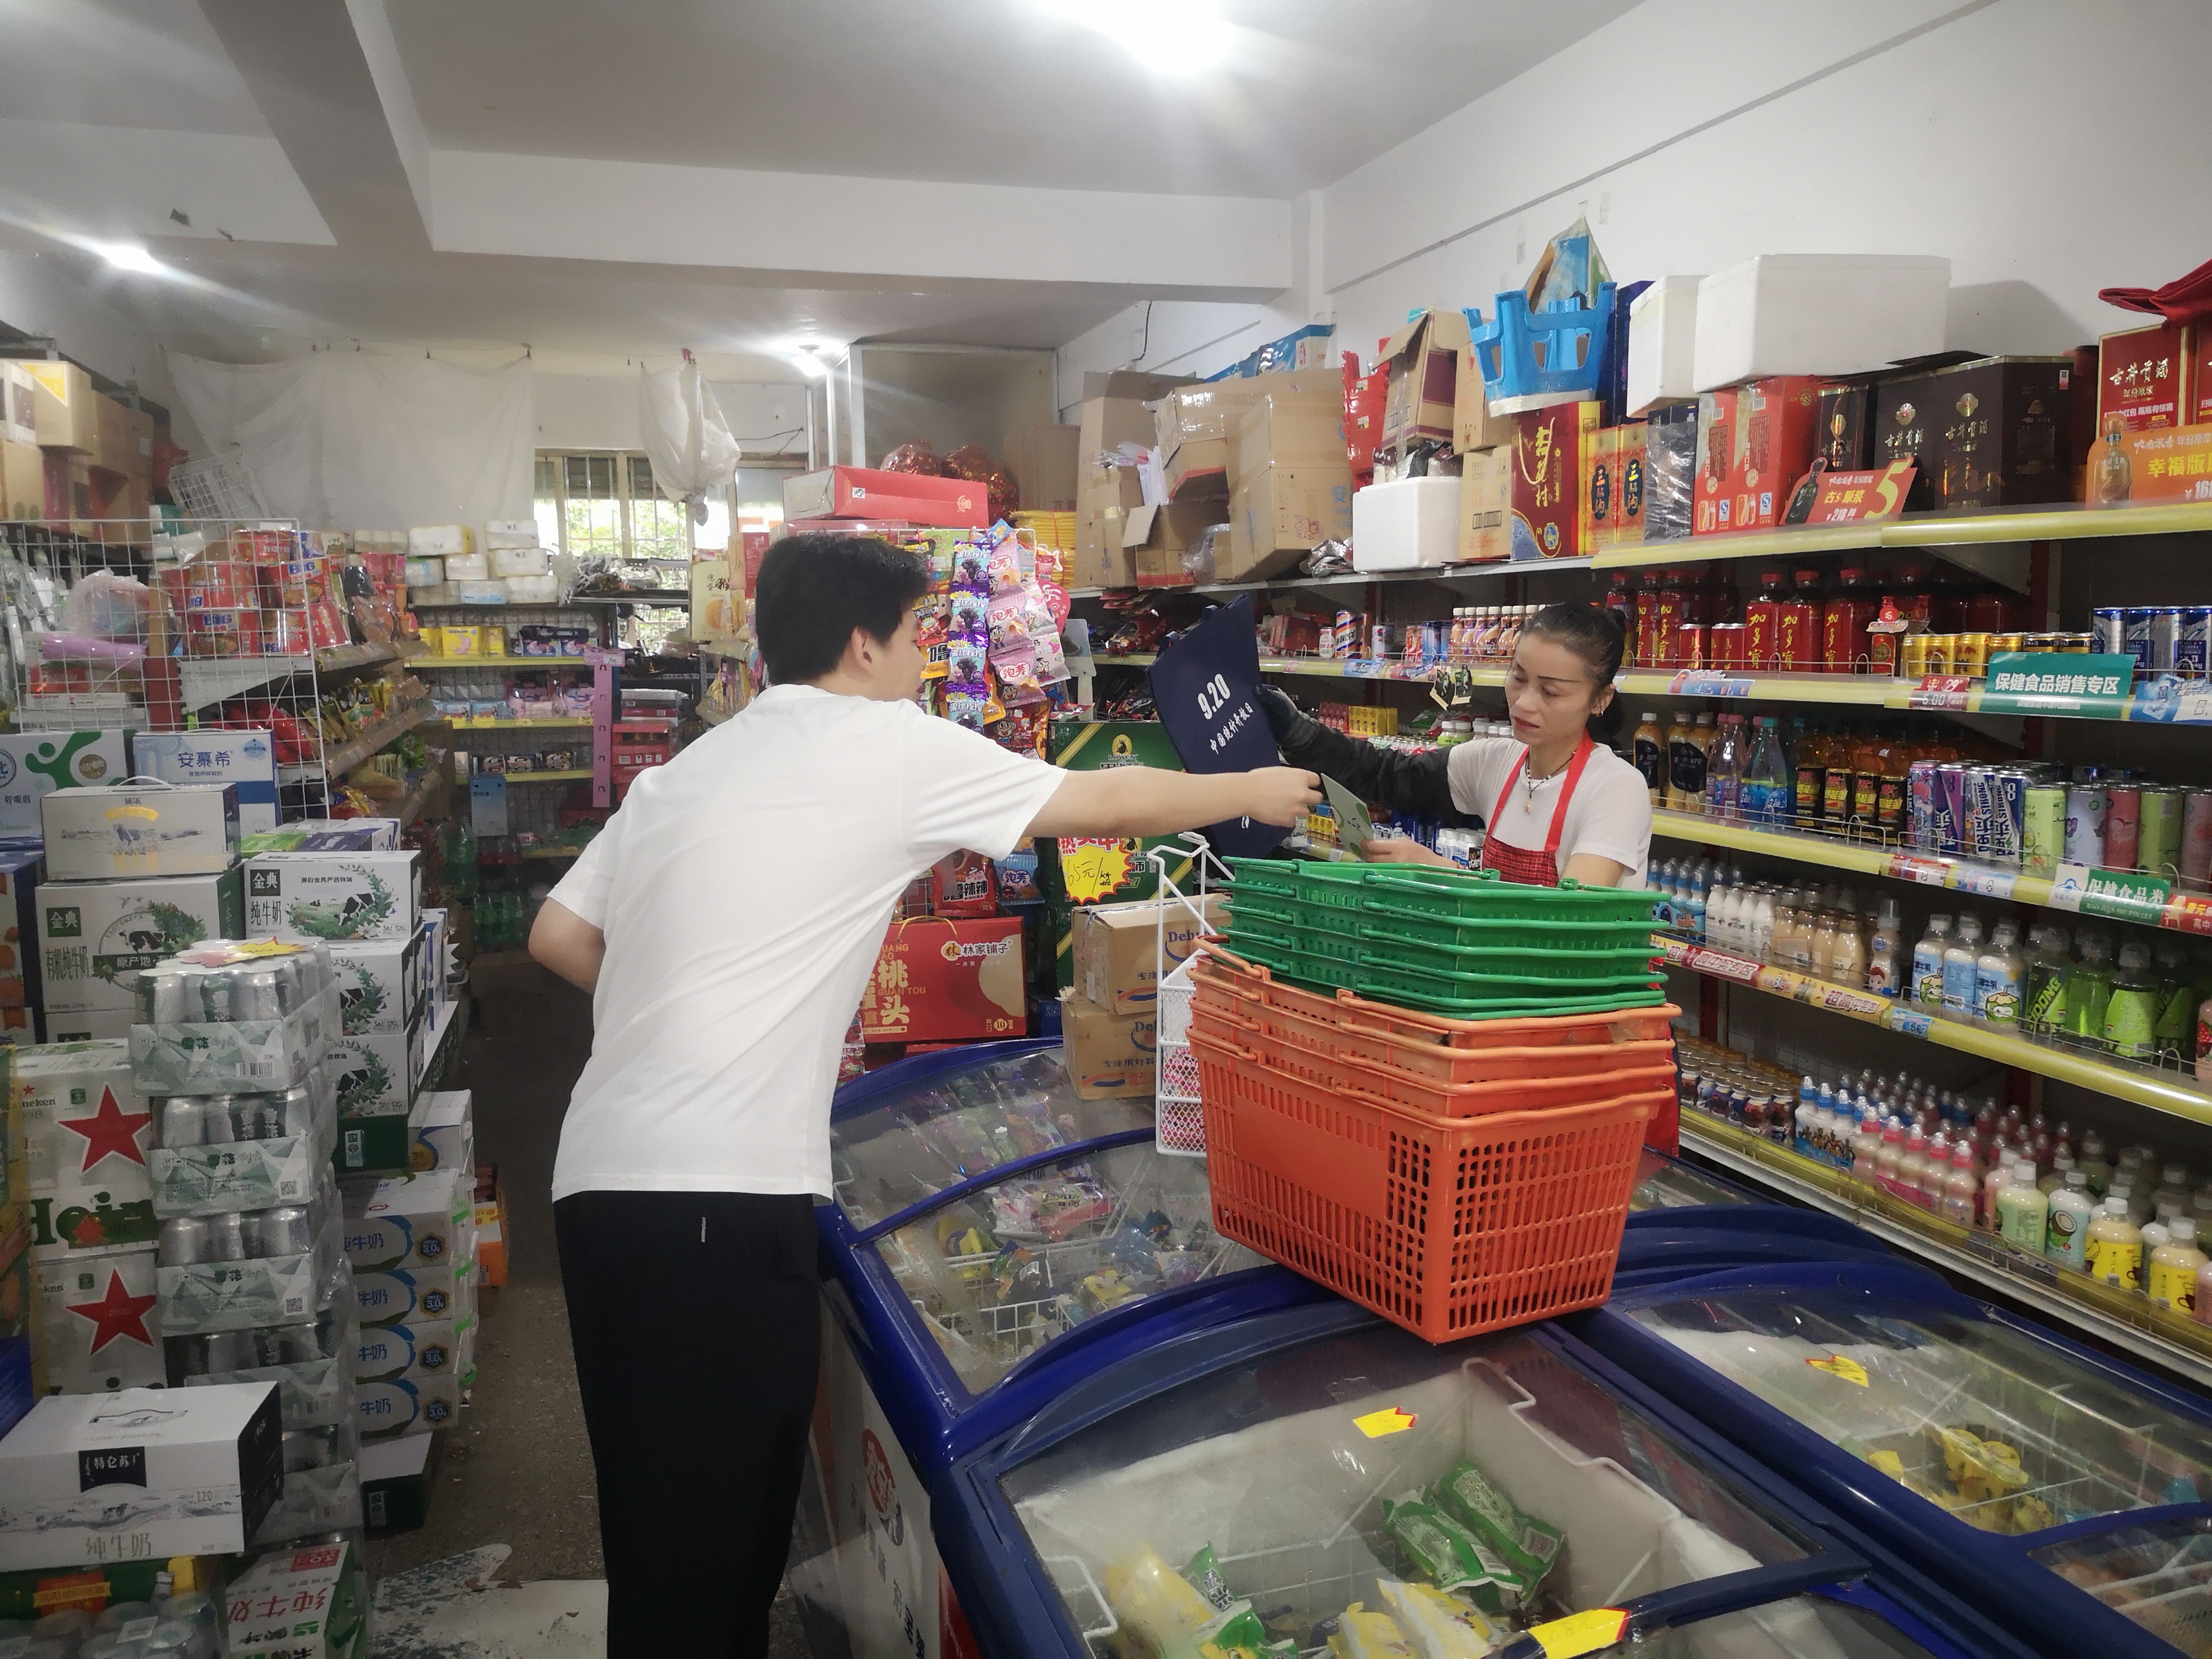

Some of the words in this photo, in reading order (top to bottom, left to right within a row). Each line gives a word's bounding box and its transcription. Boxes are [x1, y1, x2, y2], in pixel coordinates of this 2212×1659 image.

[1995, 672, 2121, 695] 保健食品销售专区
[1198, 673, 1231, 720] 9.20
[1210, 702, 1254, 755] 中国统计开放日
[177, 751, 232, 768] 安慕希
[253, 872, 279, 890] 金典
[50, 910, 78, 929] 金典
[250, 900, 282, 926] 纯牛奶
[881, 943, 909, 952] UANG
[963, 943, 1010, 955] 林家铺子
[877, 959, 909, 989] 桃
[906, 986, 926, 995] TOU
[880, 994, 910, 1025] 头
